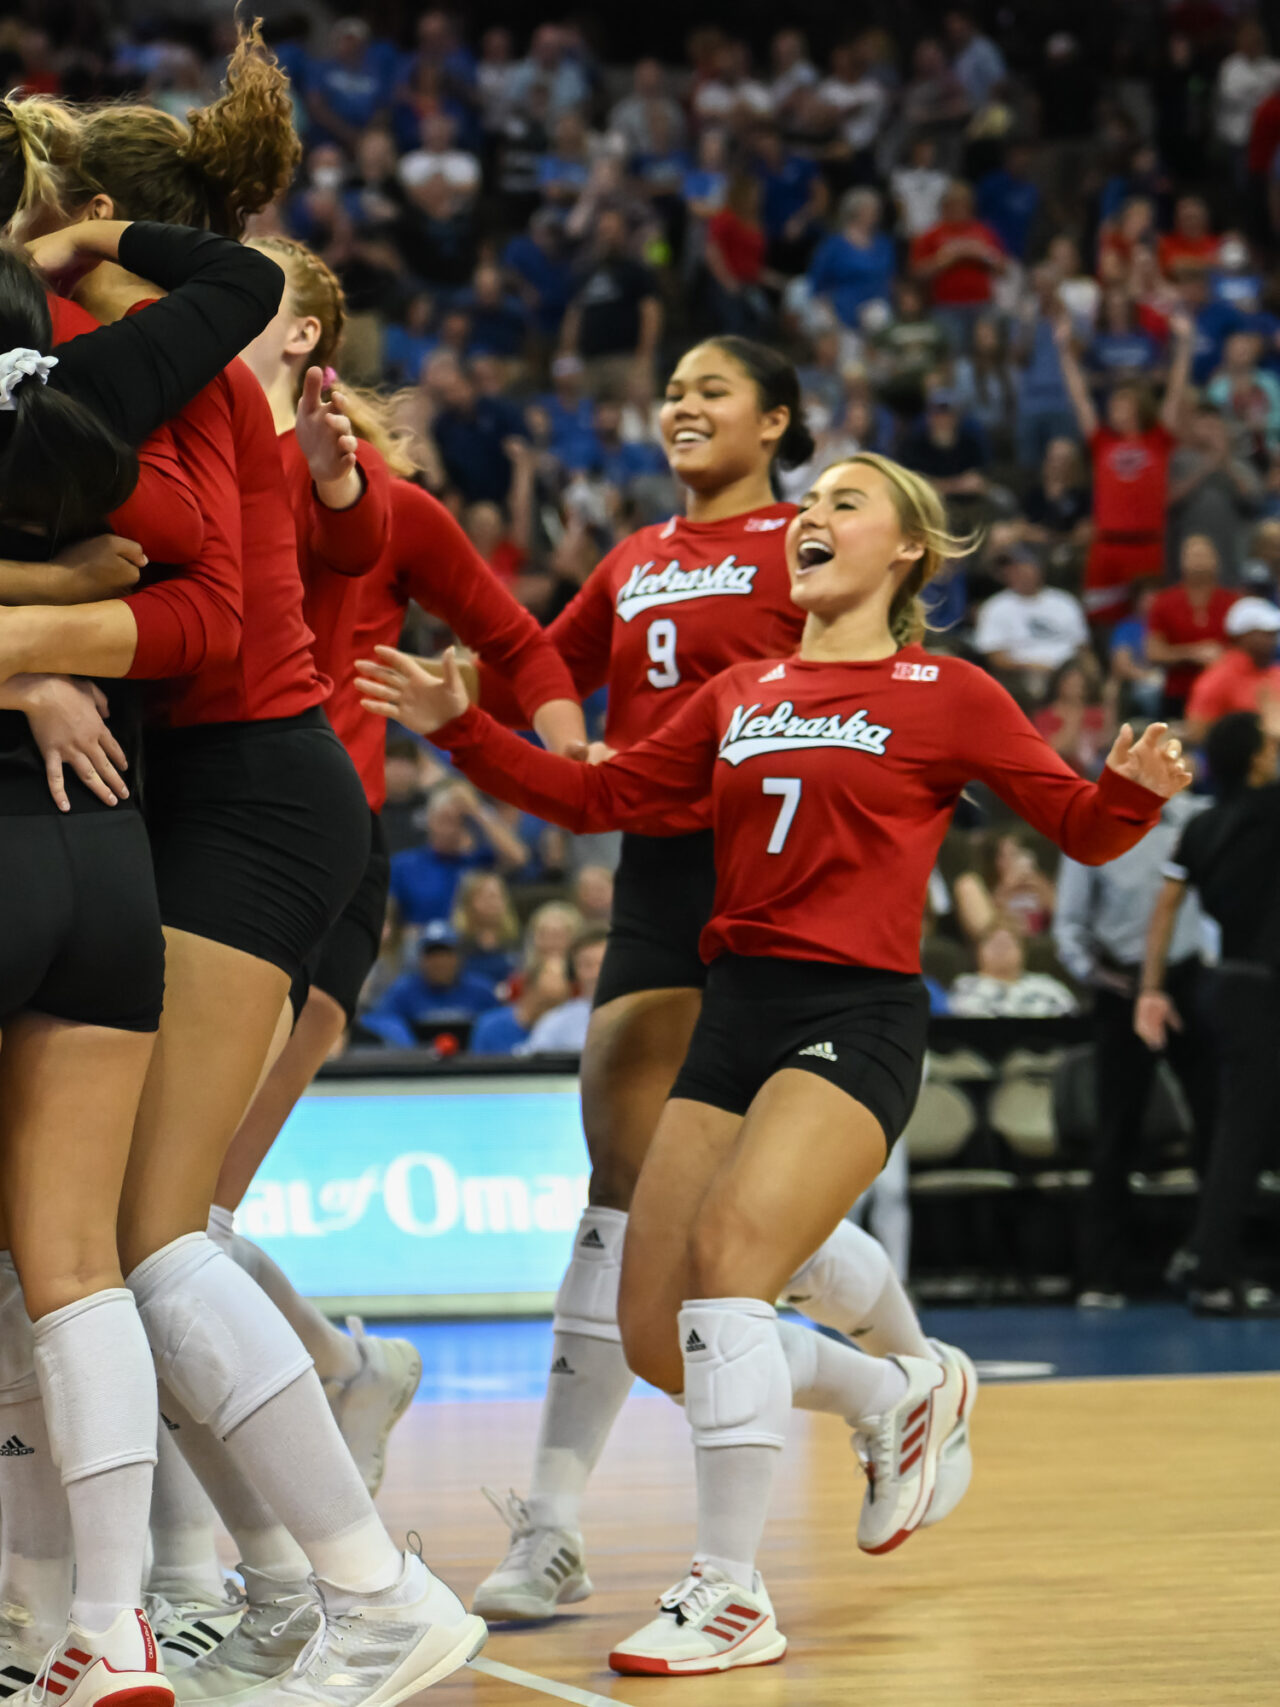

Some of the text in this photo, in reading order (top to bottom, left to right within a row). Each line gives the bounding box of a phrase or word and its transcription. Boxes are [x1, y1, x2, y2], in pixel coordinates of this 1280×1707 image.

[616, 554, 758, 604] Nebraska
[647, 618, 680, 689] 9
[718, 700, 892, 758] Nebraska
[762, 777, 802, 855] 7
